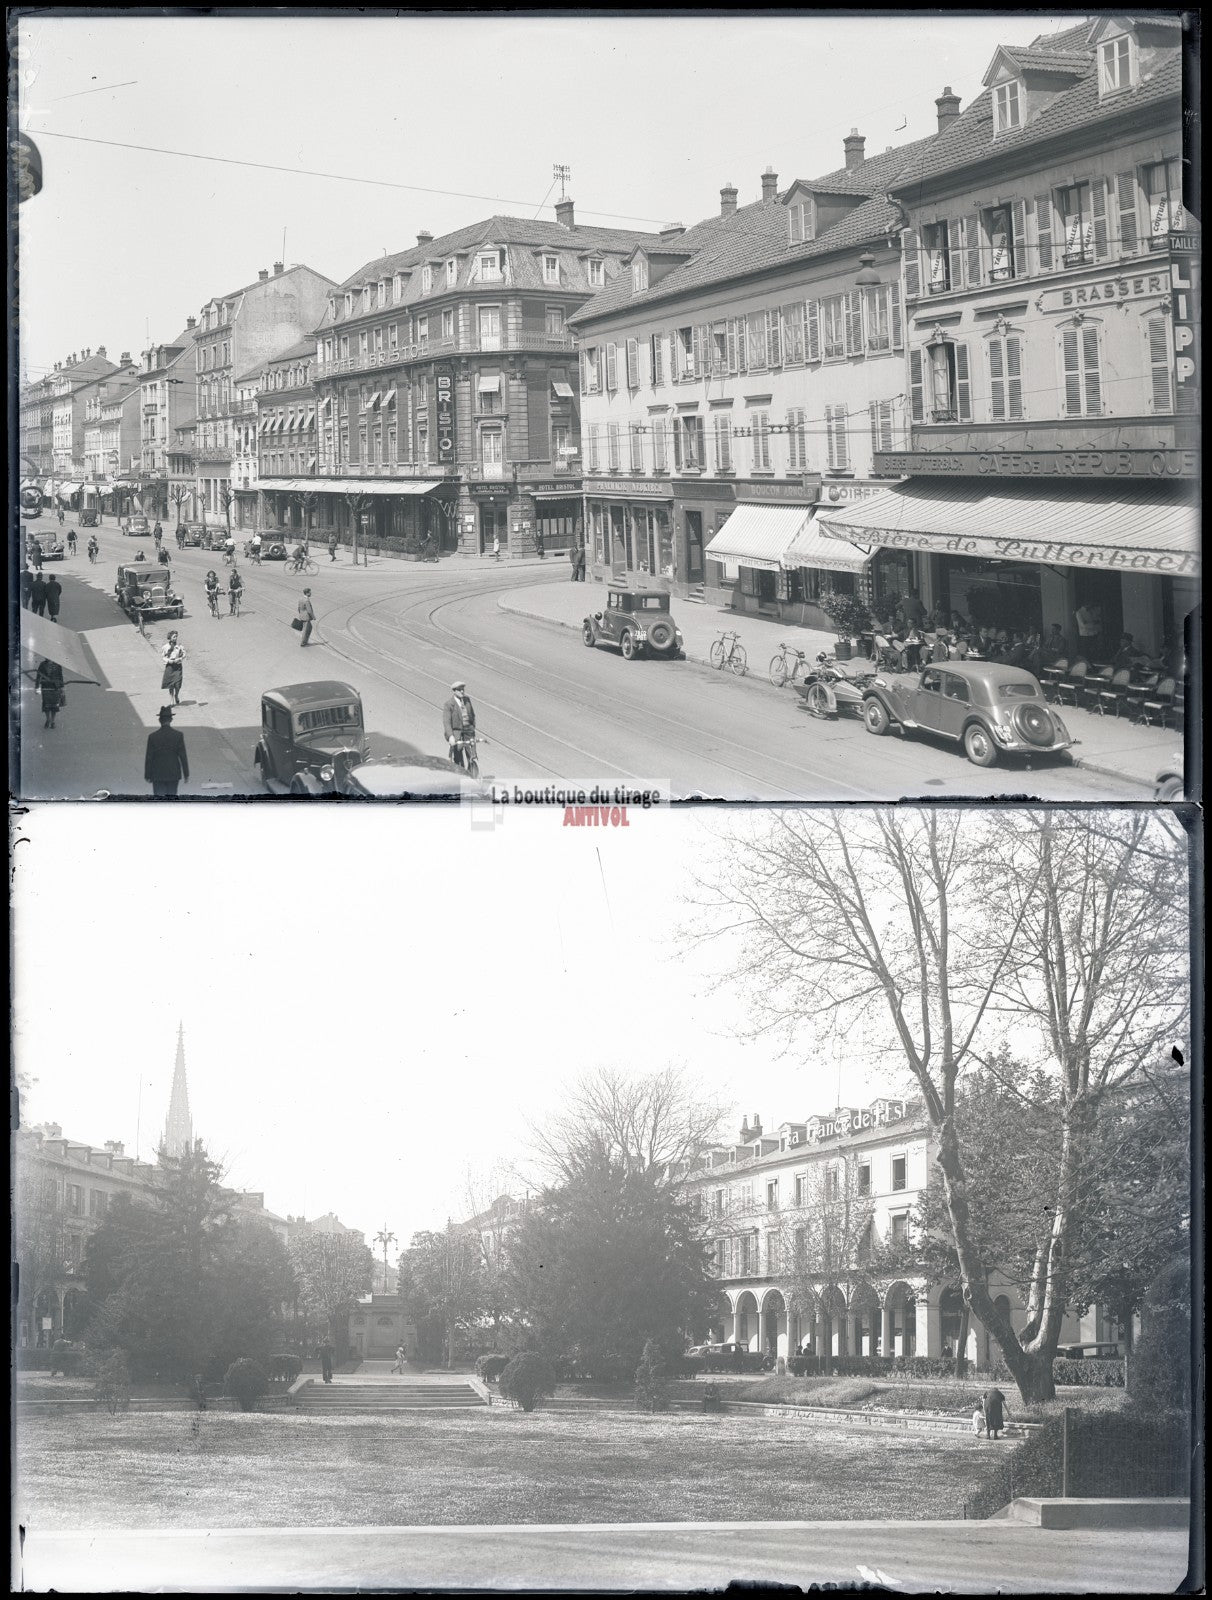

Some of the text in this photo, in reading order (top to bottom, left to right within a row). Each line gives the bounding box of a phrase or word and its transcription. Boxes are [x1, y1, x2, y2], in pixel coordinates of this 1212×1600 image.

[1153, 196, 1168, 232] COUTURE
[1171, 263, 1195, 383] LIPP
[326, 344, 429, 373] HOTEL BRISTOL
[438, 376, 454, 461] BRISTOL
[946, 537, 978, 553] de
[994, 540, 1200, 574] Lutterbach
[853, 1108, 869, 1129] de
